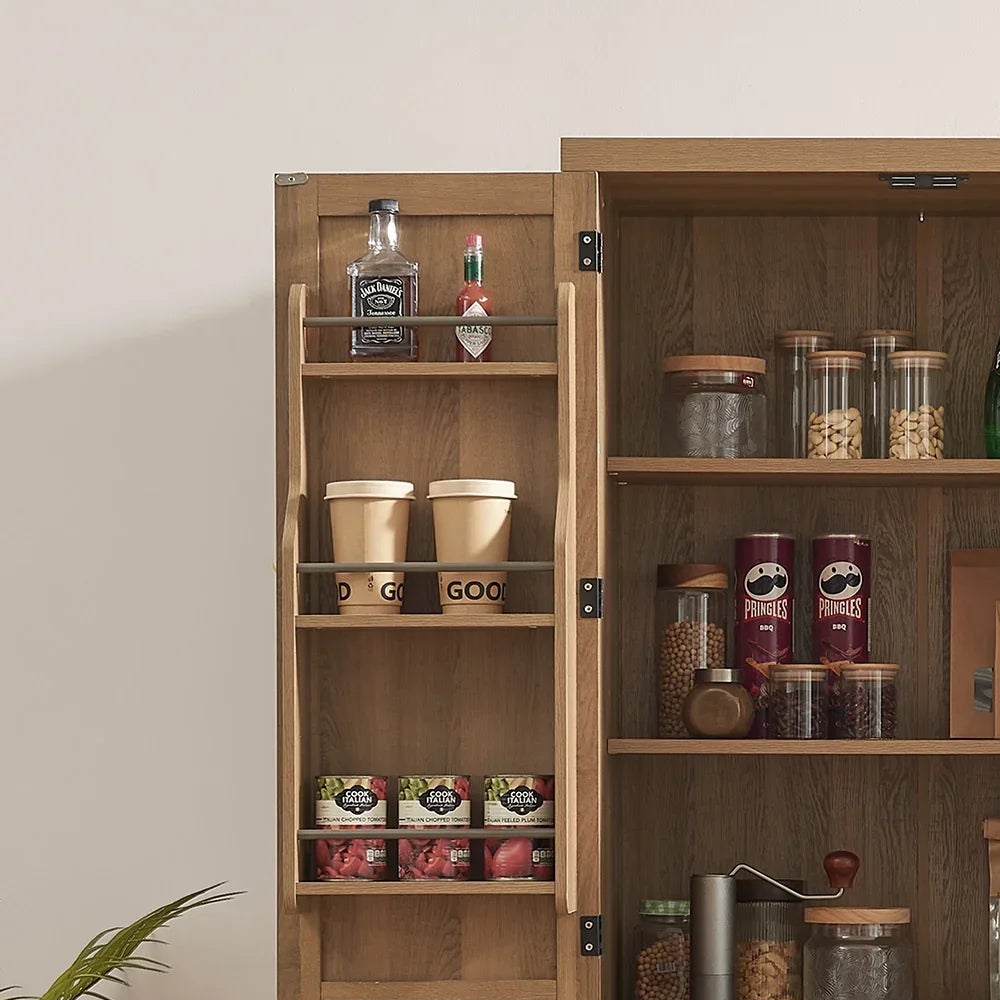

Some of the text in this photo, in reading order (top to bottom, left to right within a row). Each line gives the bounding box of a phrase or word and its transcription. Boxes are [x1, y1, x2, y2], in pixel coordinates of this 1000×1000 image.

[360, 284, 376, 299] JACK
[744, 598, 788, 620] PRINGLES
[818, 597, 862, 620] PRINGLES
[759, 624, 774, 632] BBQ
[832, 623, 847, 631] BBQ
[345, 790, 369, 798] COOK
[429, 790, 453, 798] COOK
[342, 796, 373, 804] ITALIAN
[426, 796, 456, 804] ITALIAN
